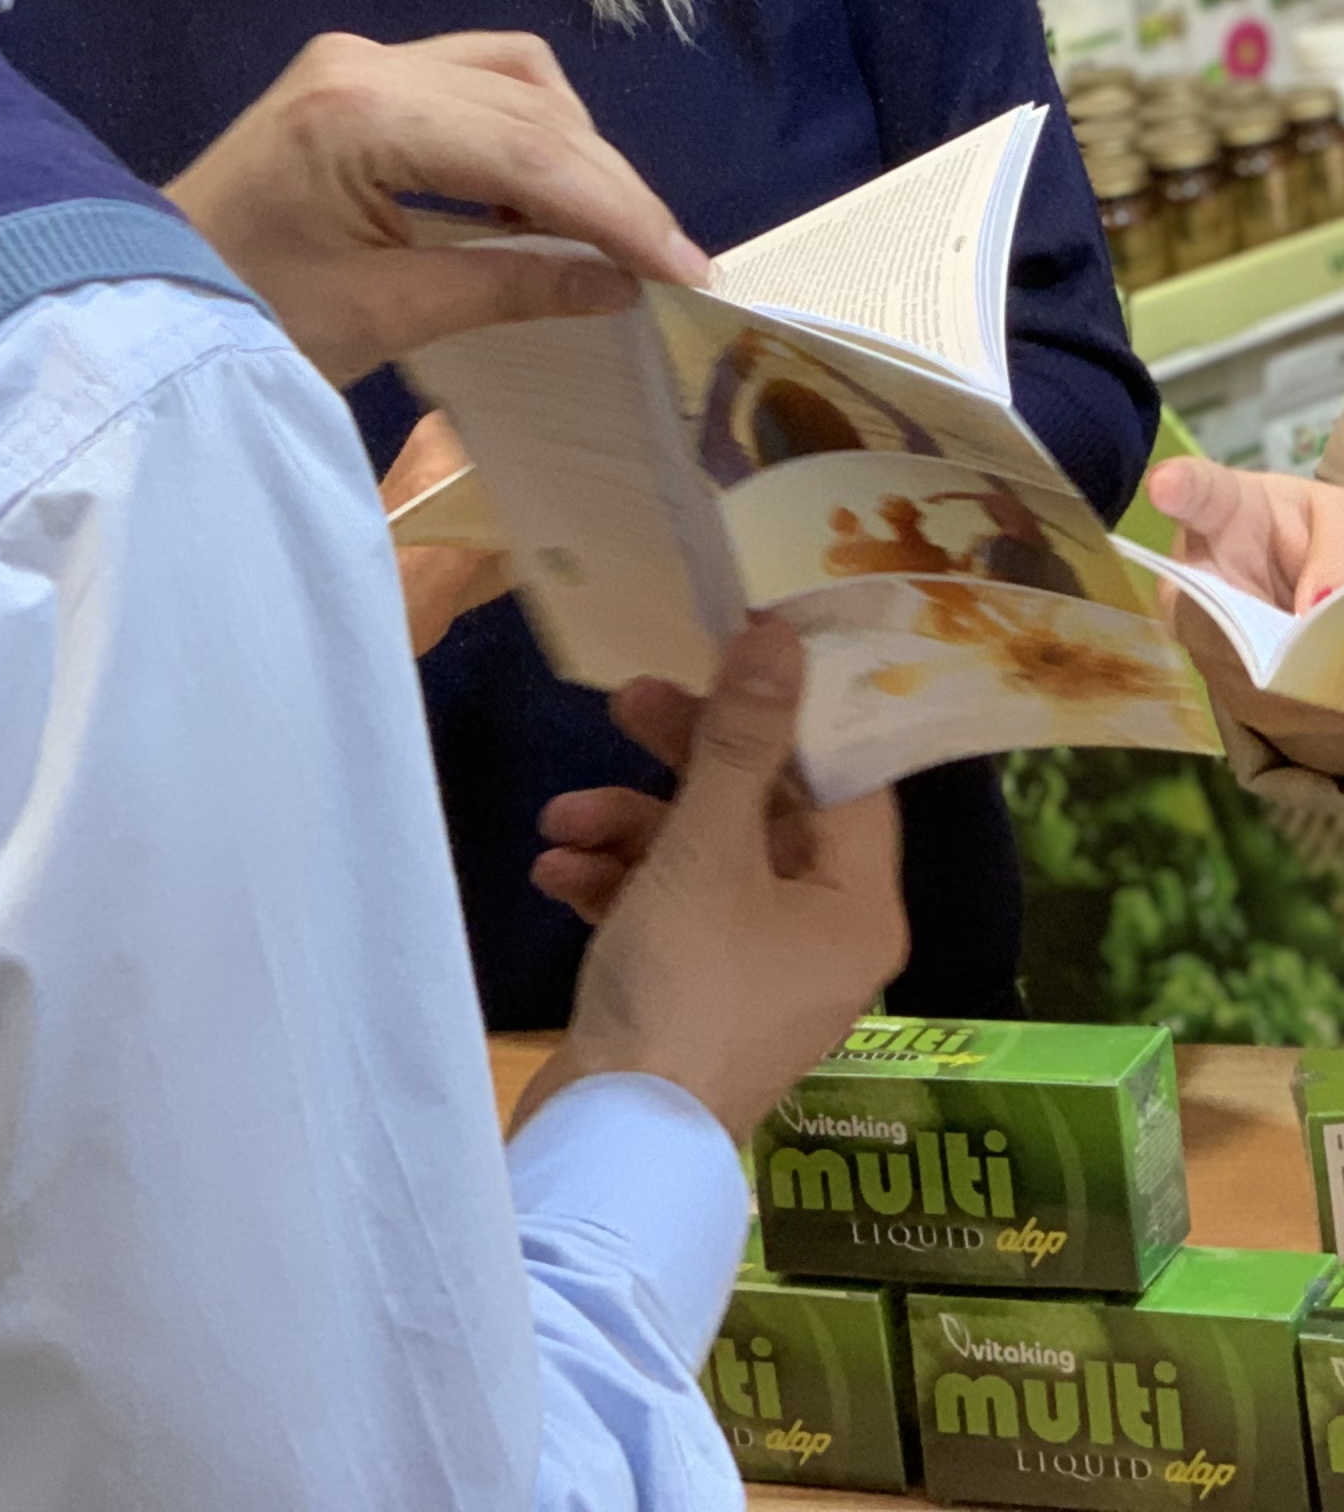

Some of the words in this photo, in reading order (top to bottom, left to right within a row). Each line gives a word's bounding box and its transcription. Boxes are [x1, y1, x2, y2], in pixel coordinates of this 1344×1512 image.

[844, 1028, 974, 1053] ulti
[800, 1111, 908, 1145] vitaking
[768, 1130, 1016, 1219] multi
[852, 1223, 985, 1253] LIQUID
[995, 1216, 1068, 1267] alap
[970, 1339, 1076, 1374] vitaking
[933, 1360, 1185, 1451] multi
[764, 1418, 832, 1467] alap
[1016, 1448, 1153, 1483] LIQUID
[1164, 1448, 1237, 1501] alap
